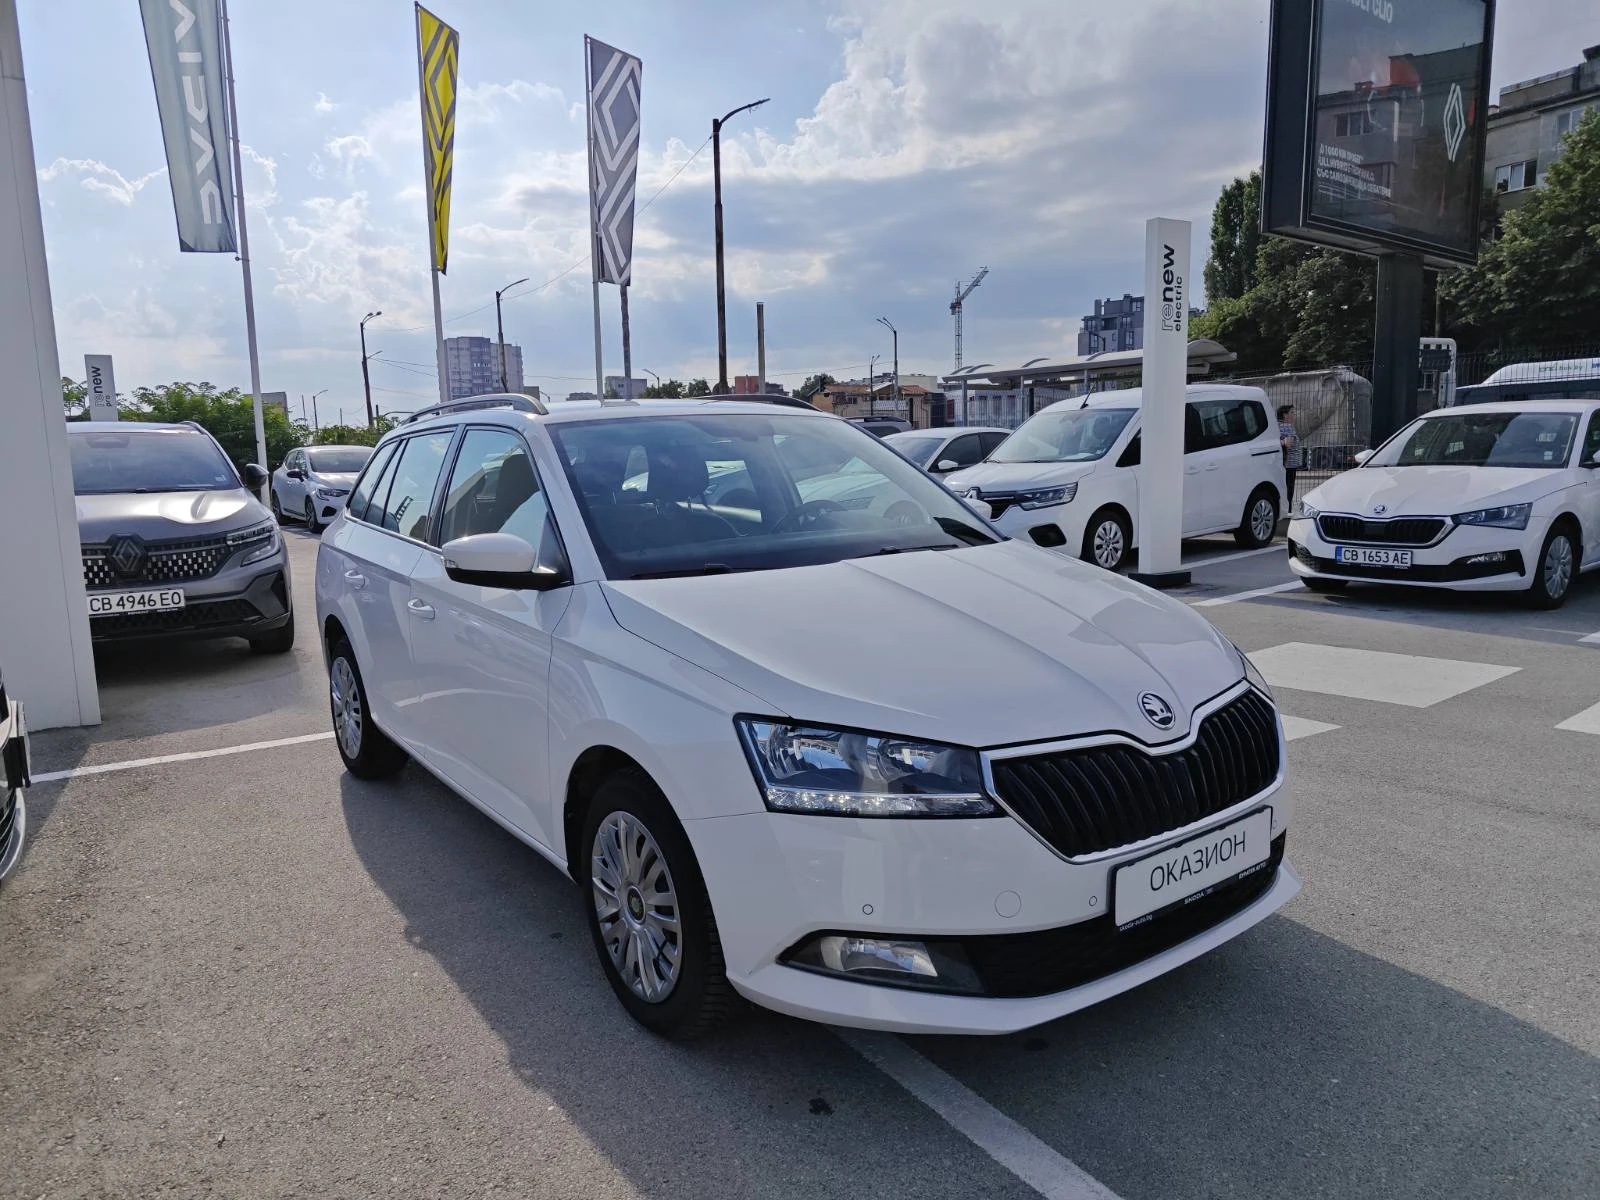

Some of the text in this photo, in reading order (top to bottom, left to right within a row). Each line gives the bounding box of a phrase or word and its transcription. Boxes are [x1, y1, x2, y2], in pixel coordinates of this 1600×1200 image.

[1161, 244, 1175, 331] renew
[1174, 276, 1183, 332] electric
[1343, 549, 1409, 565] CB 1653 AE
[89, 597, 113, 612] CB
[116, 593, 157, 610] 4946
[1150, 831, 1246, 892] ОКАЗИОН
